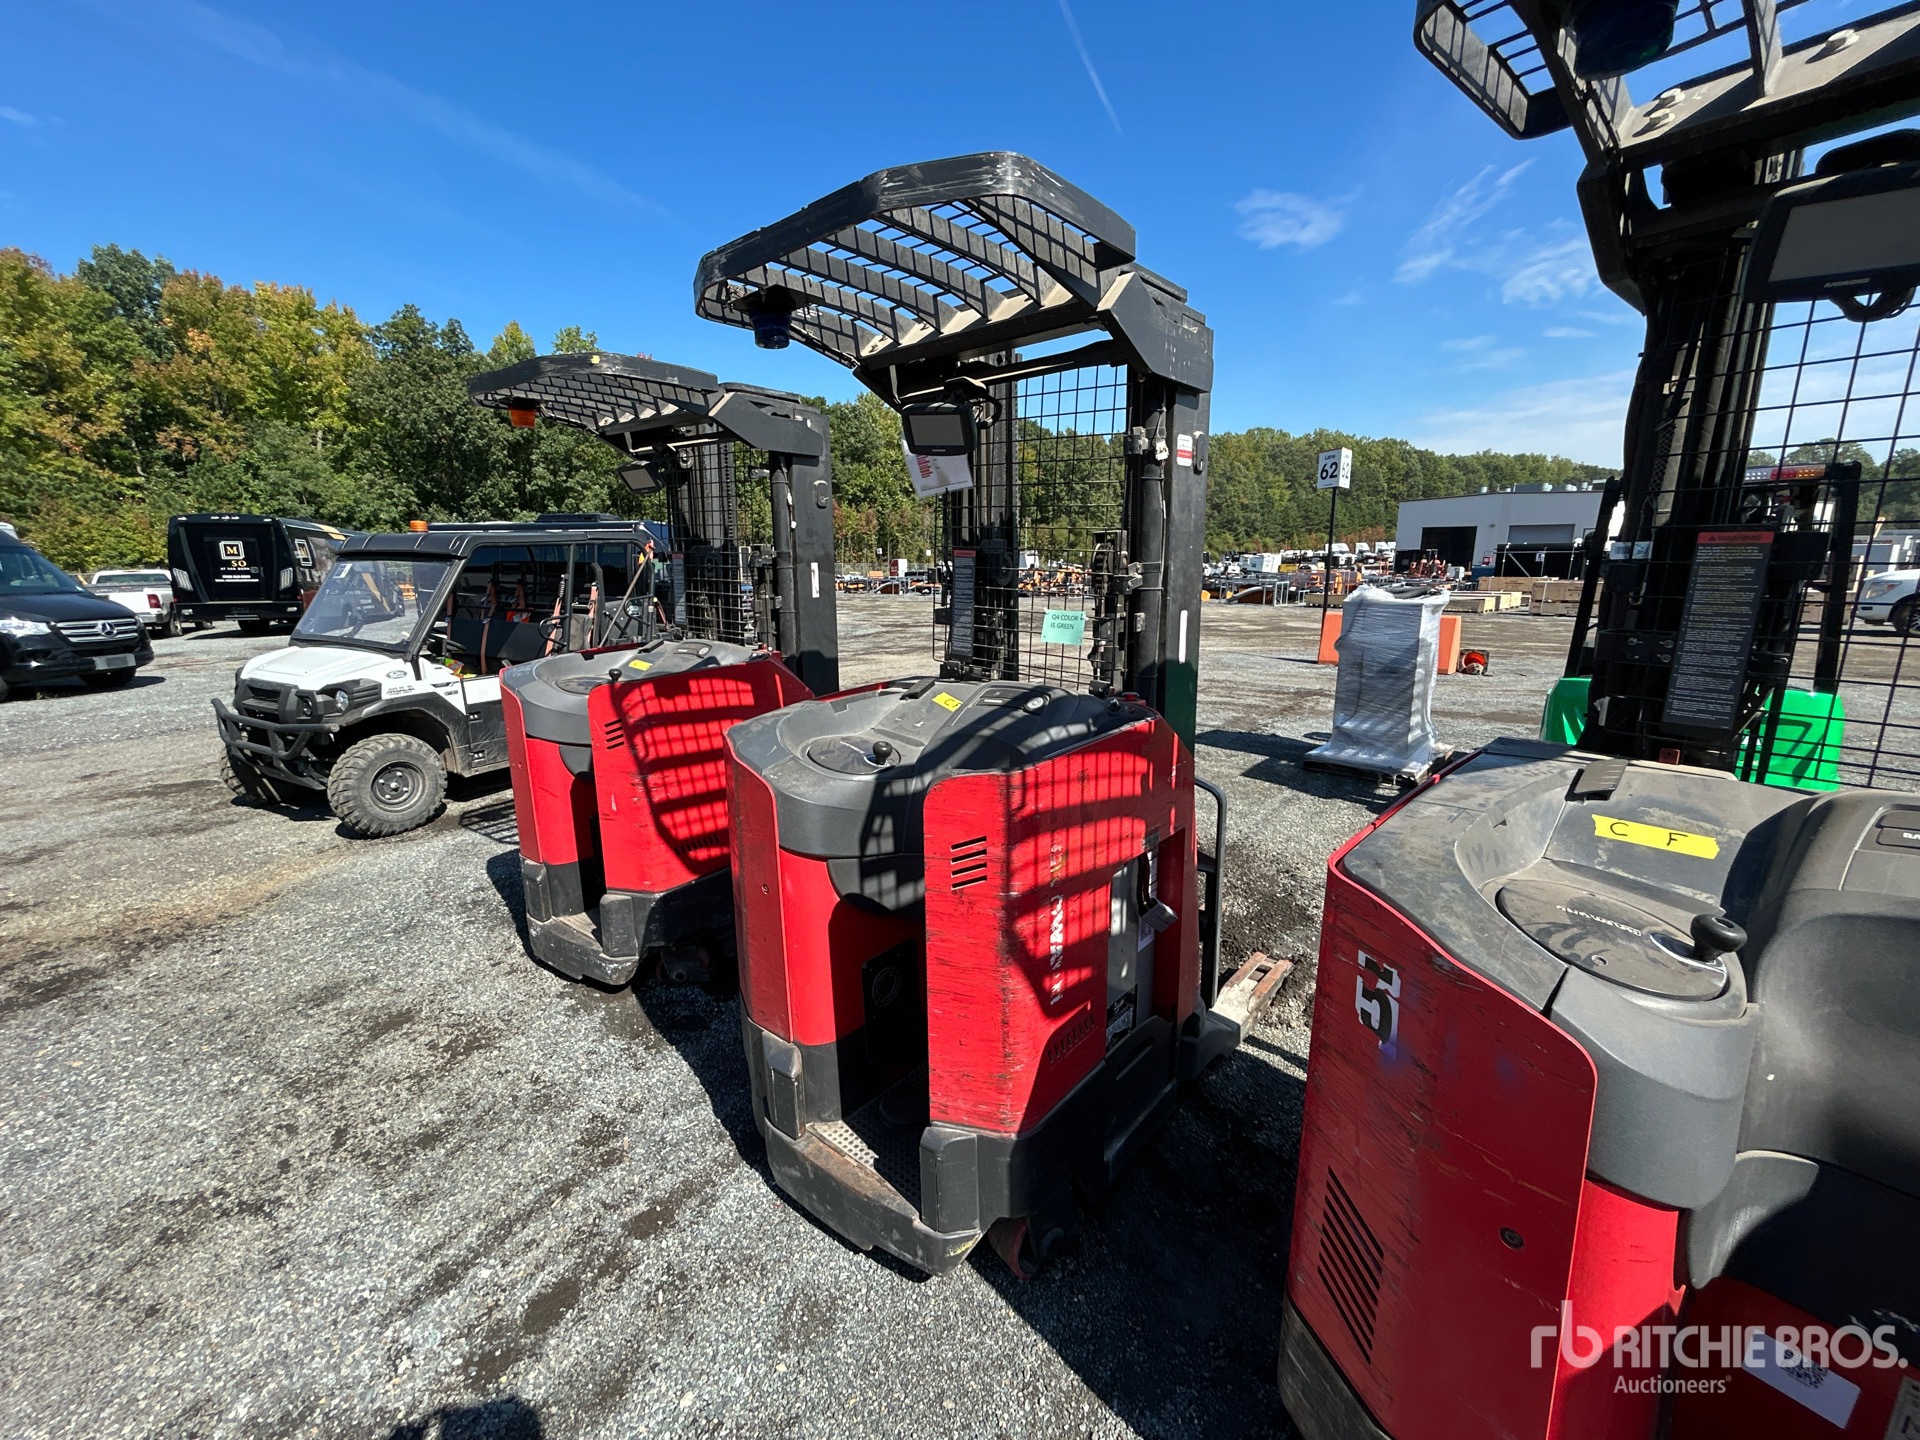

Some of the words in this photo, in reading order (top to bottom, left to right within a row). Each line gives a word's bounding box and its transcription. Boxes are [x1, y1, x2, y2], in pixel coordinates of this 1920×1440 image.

[1320, 461, 1339, 480] 62
[1341, 461, 1350, 479] 62
[225, 546, 239, 555] M
[1609, 822, 1629, 836] C
[1666, 832, 1688, 846] F
